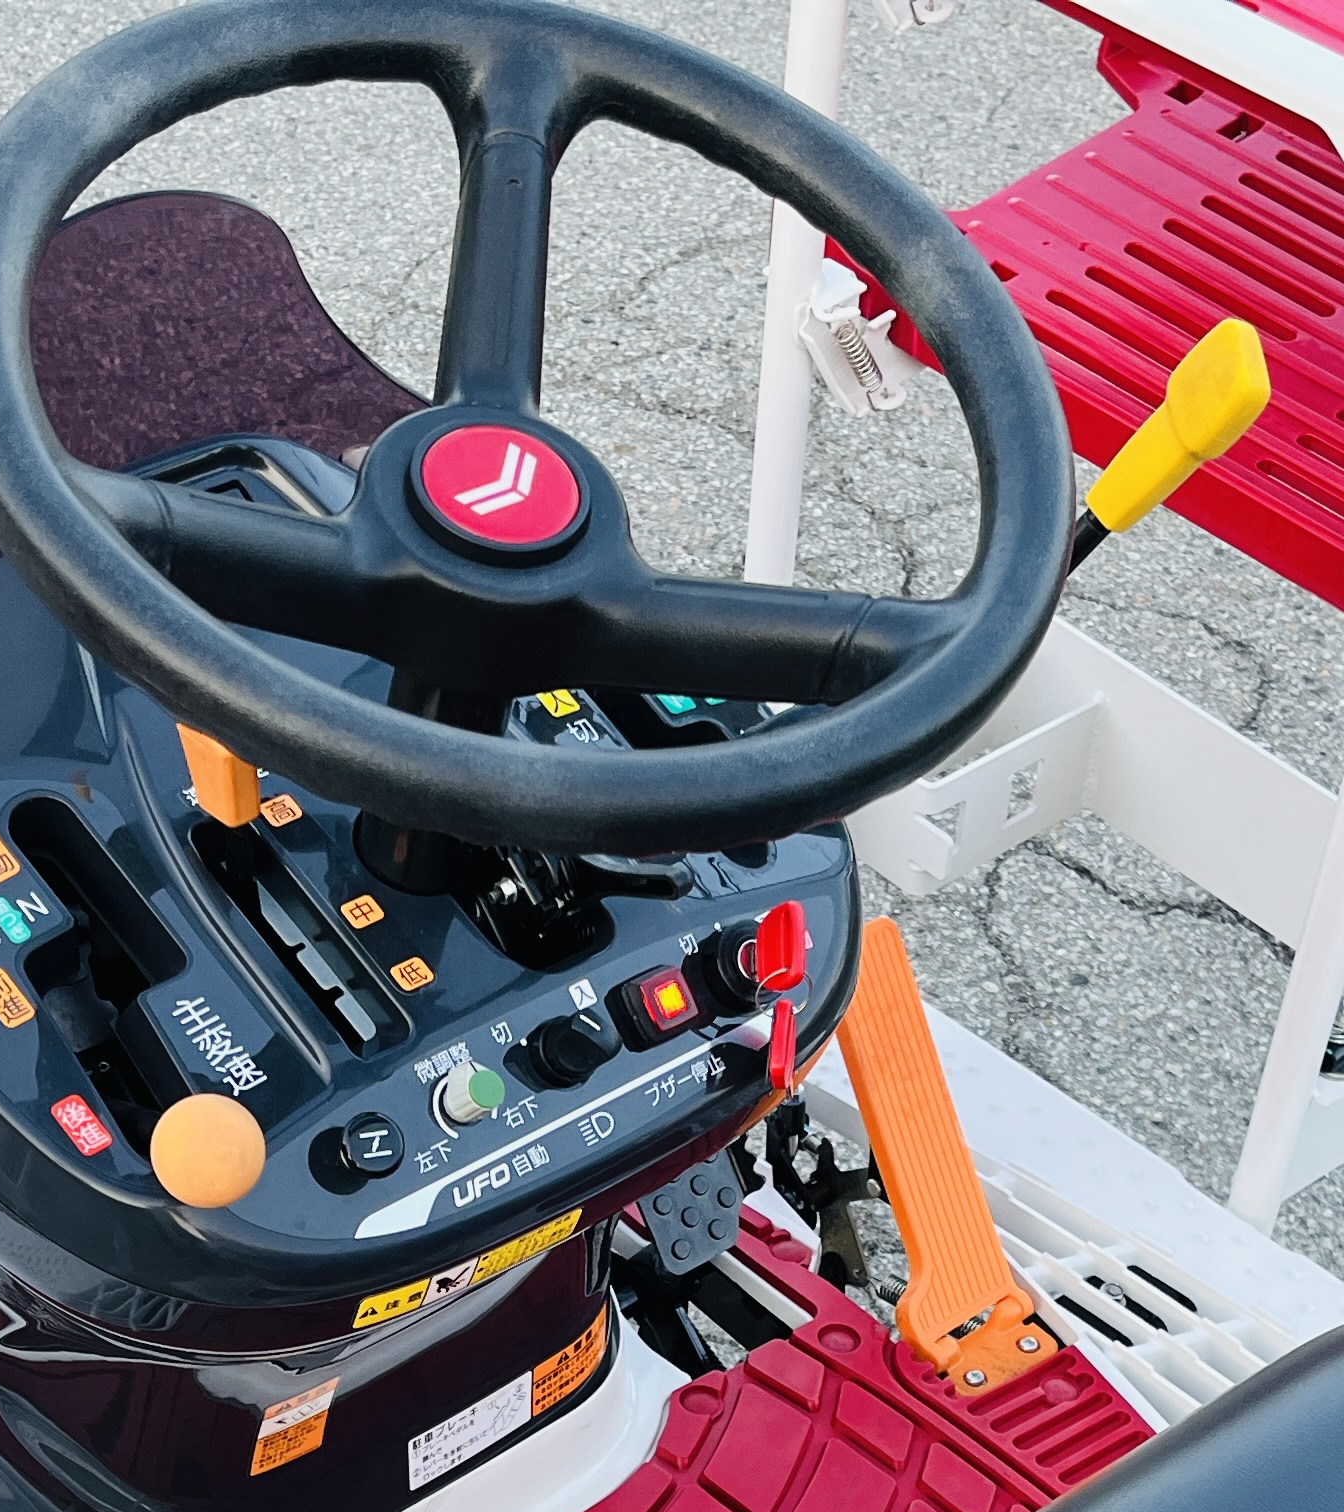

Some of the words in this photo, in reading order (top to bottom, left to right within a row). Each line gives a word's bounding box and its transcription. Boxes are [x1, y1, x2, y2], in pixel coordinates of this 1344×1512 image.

[566, 718, 599, 743] 切
[265, 799, 296, 823] 高
[16, 892, 49, 922] N
[350, 902, 374, 921] 中
[679, 933, 699, 955] 切
[399, 962, 427, 986] 低
[574, 986, 594, 1006] 入
[172, 997, 268, 1096] 主変速
[490, 1021, 513, 1045] 切
[414, 1041, 473, 1084] 微調整
[644, 1054, 726, 1107] ブザー停止
[502, 1095, 539, 1128] 右下
[57, 1101, 110, 1153] 後進
[413, 1139, 452, 1174] 左下
[452, 1162, 511, 1208] UFO
[511, 1144, 551, 1177] 自動
